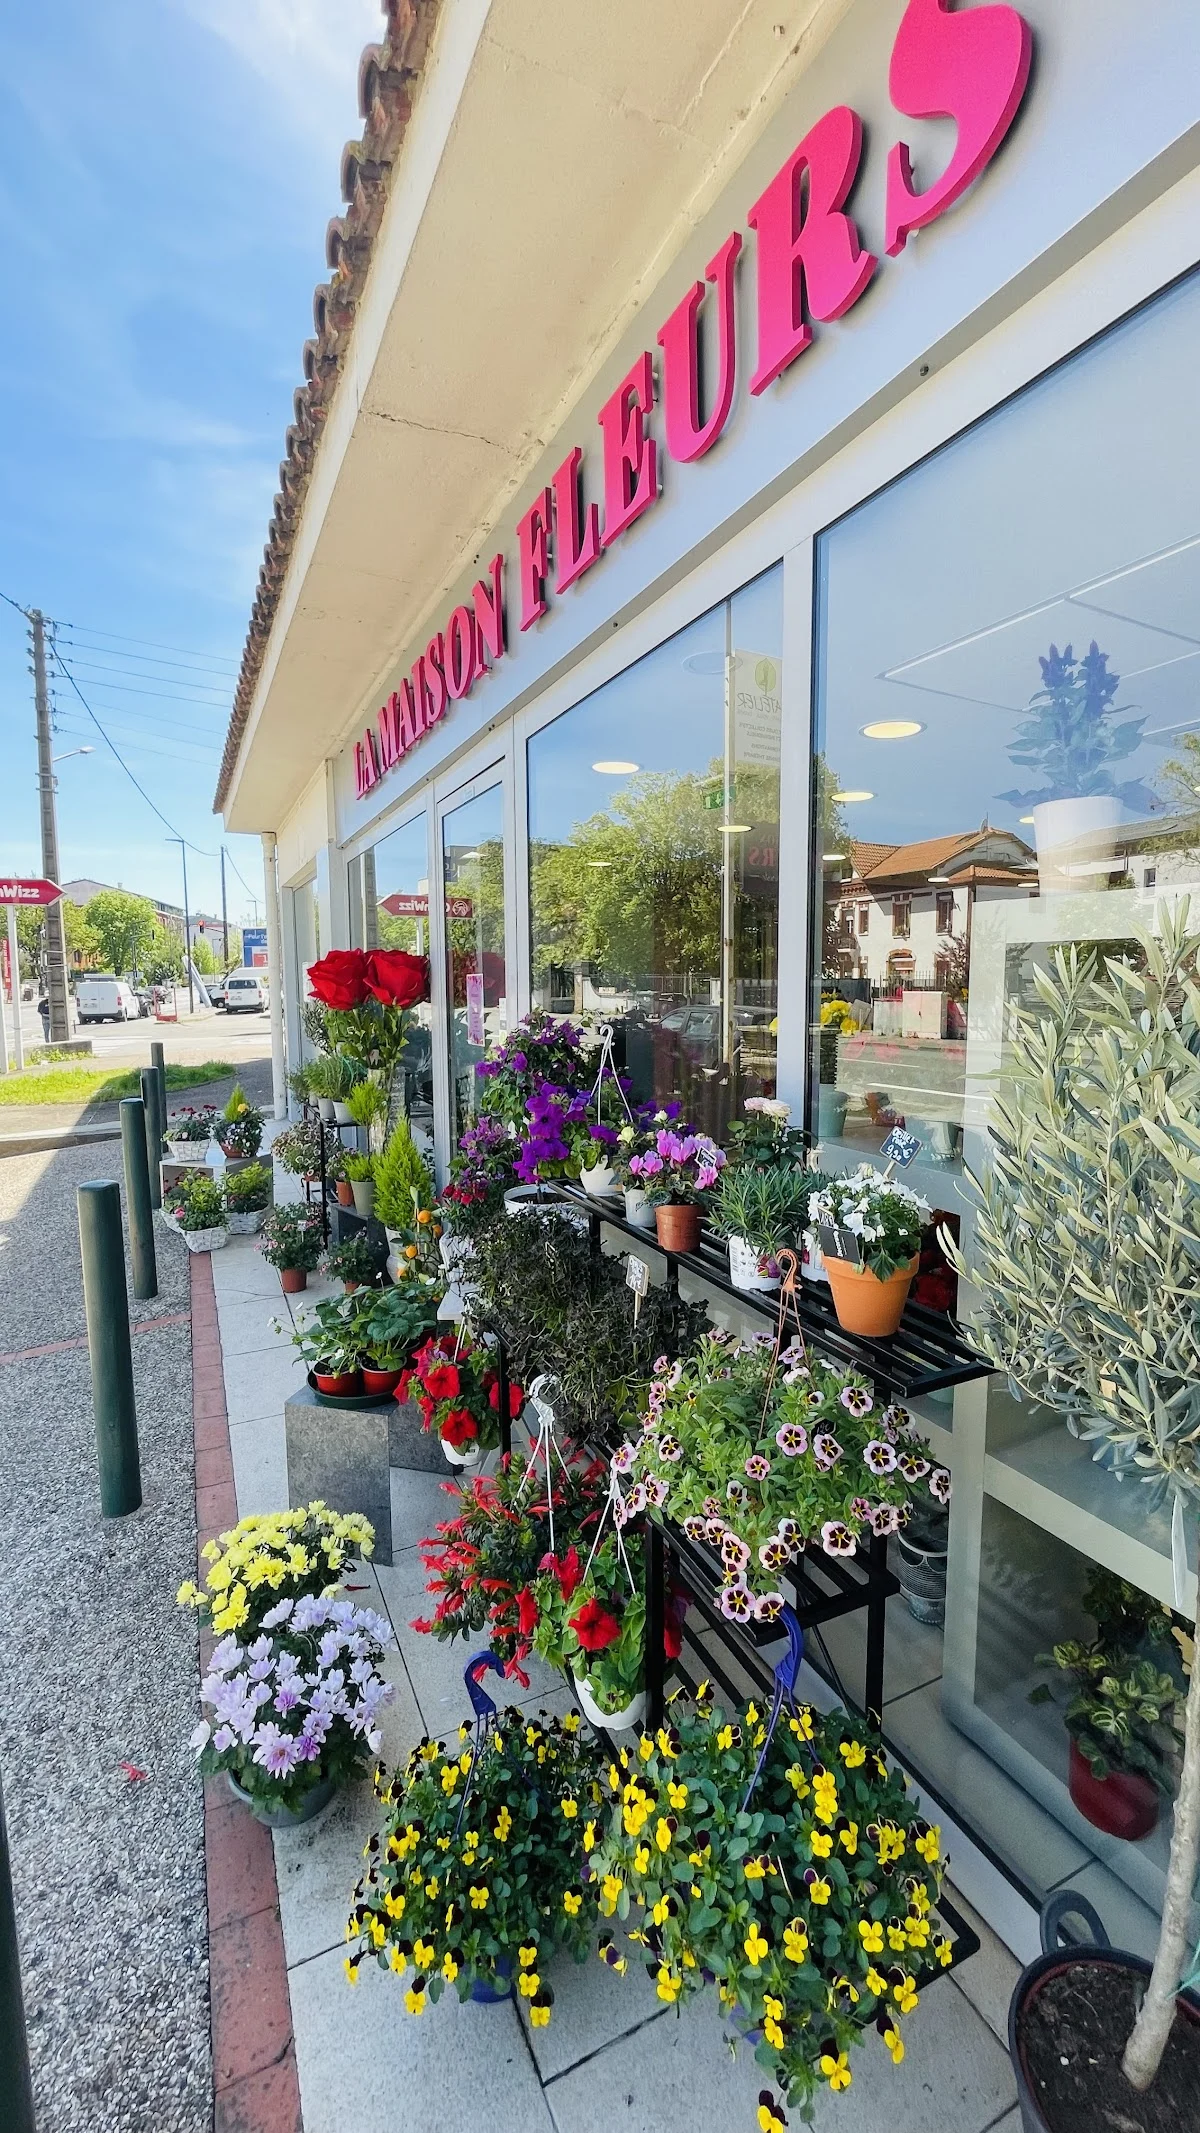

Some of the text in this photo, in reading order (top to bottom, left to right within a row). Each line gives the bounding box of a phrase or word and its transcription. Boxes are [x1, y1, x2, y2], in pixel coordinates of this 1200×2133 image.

[353, 0, 1033, 800] LA MAISON FLEURS
